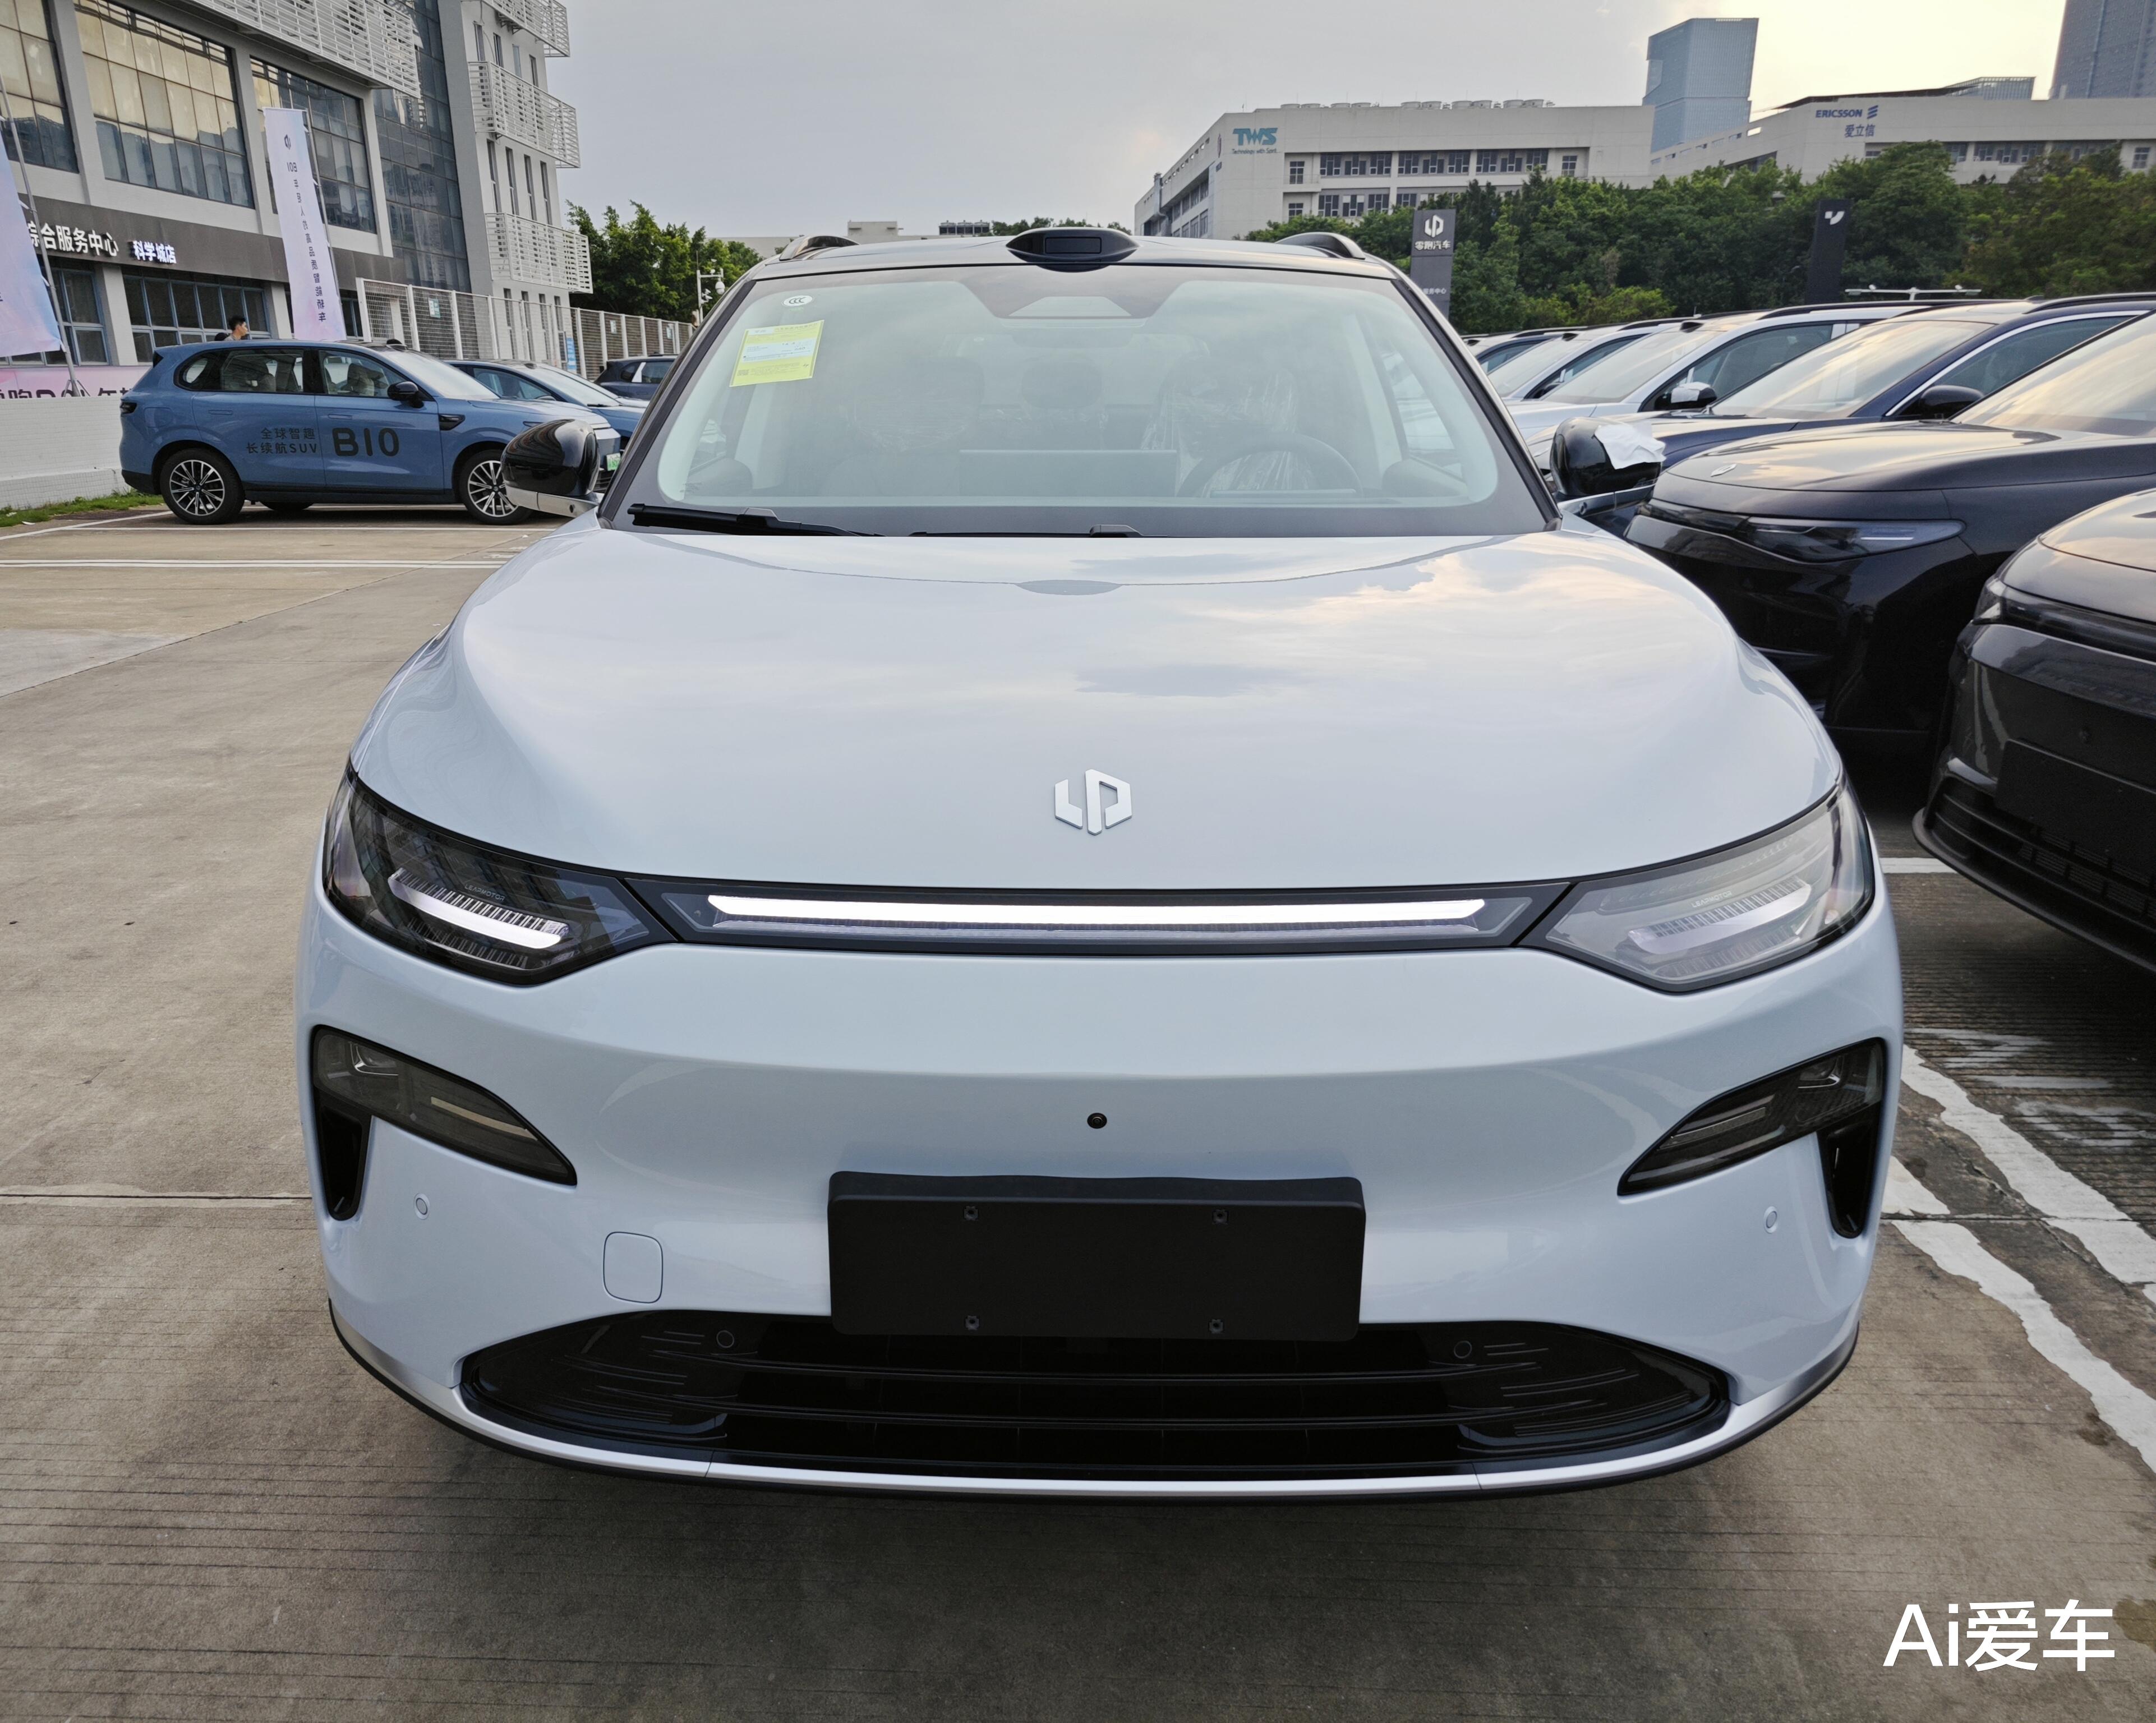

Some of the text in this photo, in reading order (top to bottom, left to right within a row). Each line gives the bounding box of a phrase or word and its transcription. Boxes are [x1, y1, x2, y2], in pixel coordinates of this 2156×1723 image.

[1815, 109, 1863, 118] ERICSSON
[1233, 128, 1278, 146] TWS
[1845, 124, 1875, 137] 爱立信
[133, 240, 177, 264] 科学城店
[1415, 240, 1451, 250] 零跑汽车
[261, 427, 315, 439] 全球智趣
[246, 443, 317, 454] 长续航SUV
[332, 427, 399, 457] B10
[464, 884, 505, 901] LEAPMOTOR
[1691, 891, 1732, 907] LEAPMOTOR
